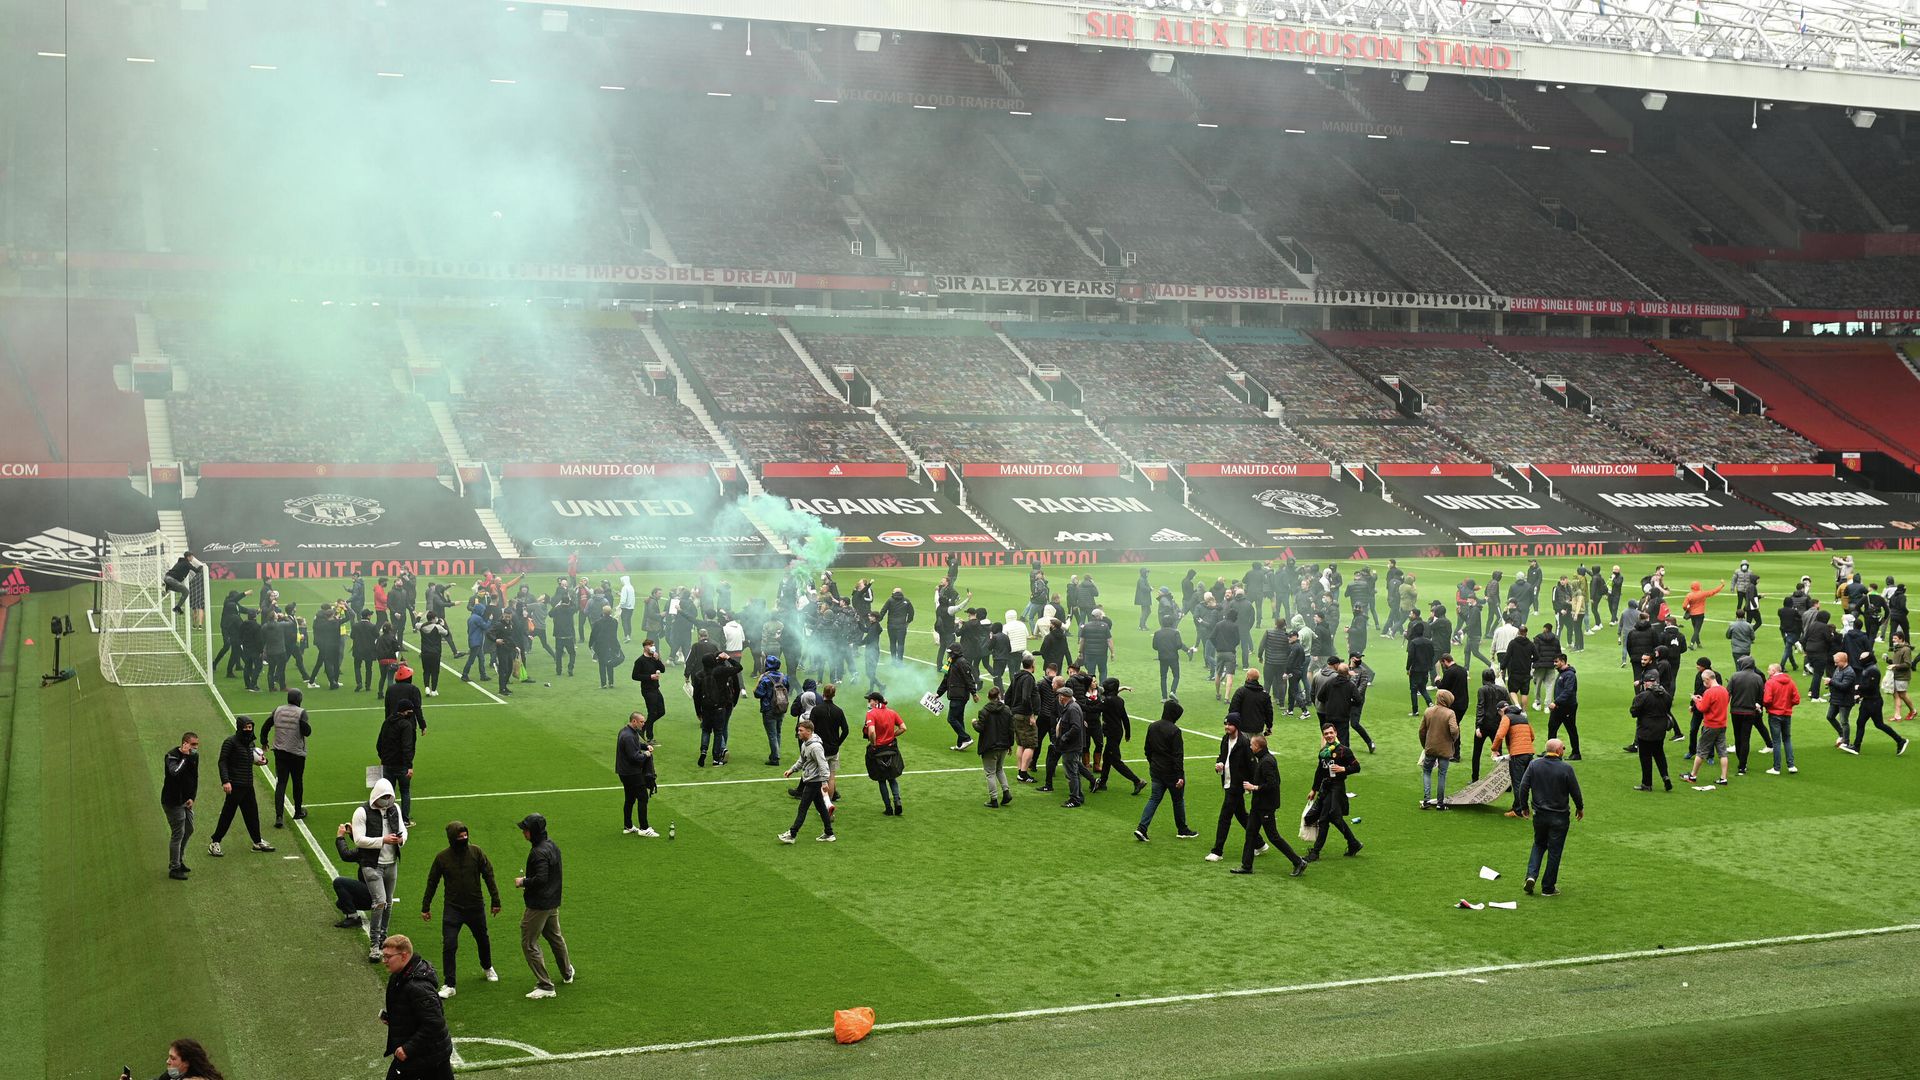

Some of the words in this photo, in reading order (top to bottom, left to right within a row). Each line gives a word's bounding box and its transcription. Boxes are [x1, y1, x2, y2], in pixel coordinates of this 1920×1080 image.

[1086, 11, 1135, 40] SIR
[1154, 17, 1230, 49] ALEX
[1245, 24, 1402, 62] FERGUSON
[1418, 40, 1512, 71] STAND
[837, 87, 901, 106] WELCOME
[907, 92, 925, 105] TO
[929, 93, 955, 107] OLD
[960, 96, 1025, 111] TRAFFORD
[1321, 119, 1403, 137] MANUTD.COM
[537, 263, 577, 279] THE
[586, 265, 715, 282] IMPOSSIBLE
[723, 270, 793, 286] DREAM
[936, 275, 967, 292] SIR
[971, 277, 1023, 292] ALEX
[1026, 279, 1048, 294] 26
[1051, 279, 1115, 296] YEARS
[1151, 285, 1197, 298] MADE
[1511, 298, 1540, 310] EVERY
[1542, 298, 1575, 312] SINGLE
[1576, 300, 1595, 313] ONE
[1597, 301, 1608, 313] OF
[1611, 302, 1624, 313] US
[1642, 303, 1669, 315] LOVES
[1671, 303, 1694, 316] ALEX
[1695, 304, 1741, 317] FERGUSON
[1857, 310, 1901, 320] GREATEST
[1903, 310, 1916, 320] OF
[560, 464, 656, 477] MANUTD.COM
[1000, 464, 1083, 476] MANUTD.COM
[1220, 465, 1297, 475] MANUTD.COM
[1571, 465, 1638, 475] MANUTD.COM
[1012, 497, 1153, 514] RACISM
[1423, 495, 1541, 510] UNITED
[1598, 493, 1723, 508] AGAINST
[1772, 492, 1889, 506] RACISM
[551, 499, 695, 517] UNITED
[790, 498, 943, 515] AGAINST
[696, 535, 761, 543] CHIVAS
[1054, 531, 1114, 541] AON
[1350, 528, 1426, 536] KOHLER
[418, 539, 487, 549] apollo
[532, 537, 601, 548] Cadbury
[1458, 545, 1528, 558] INFINITE
[256, 562, 362, 580] INFINITE
